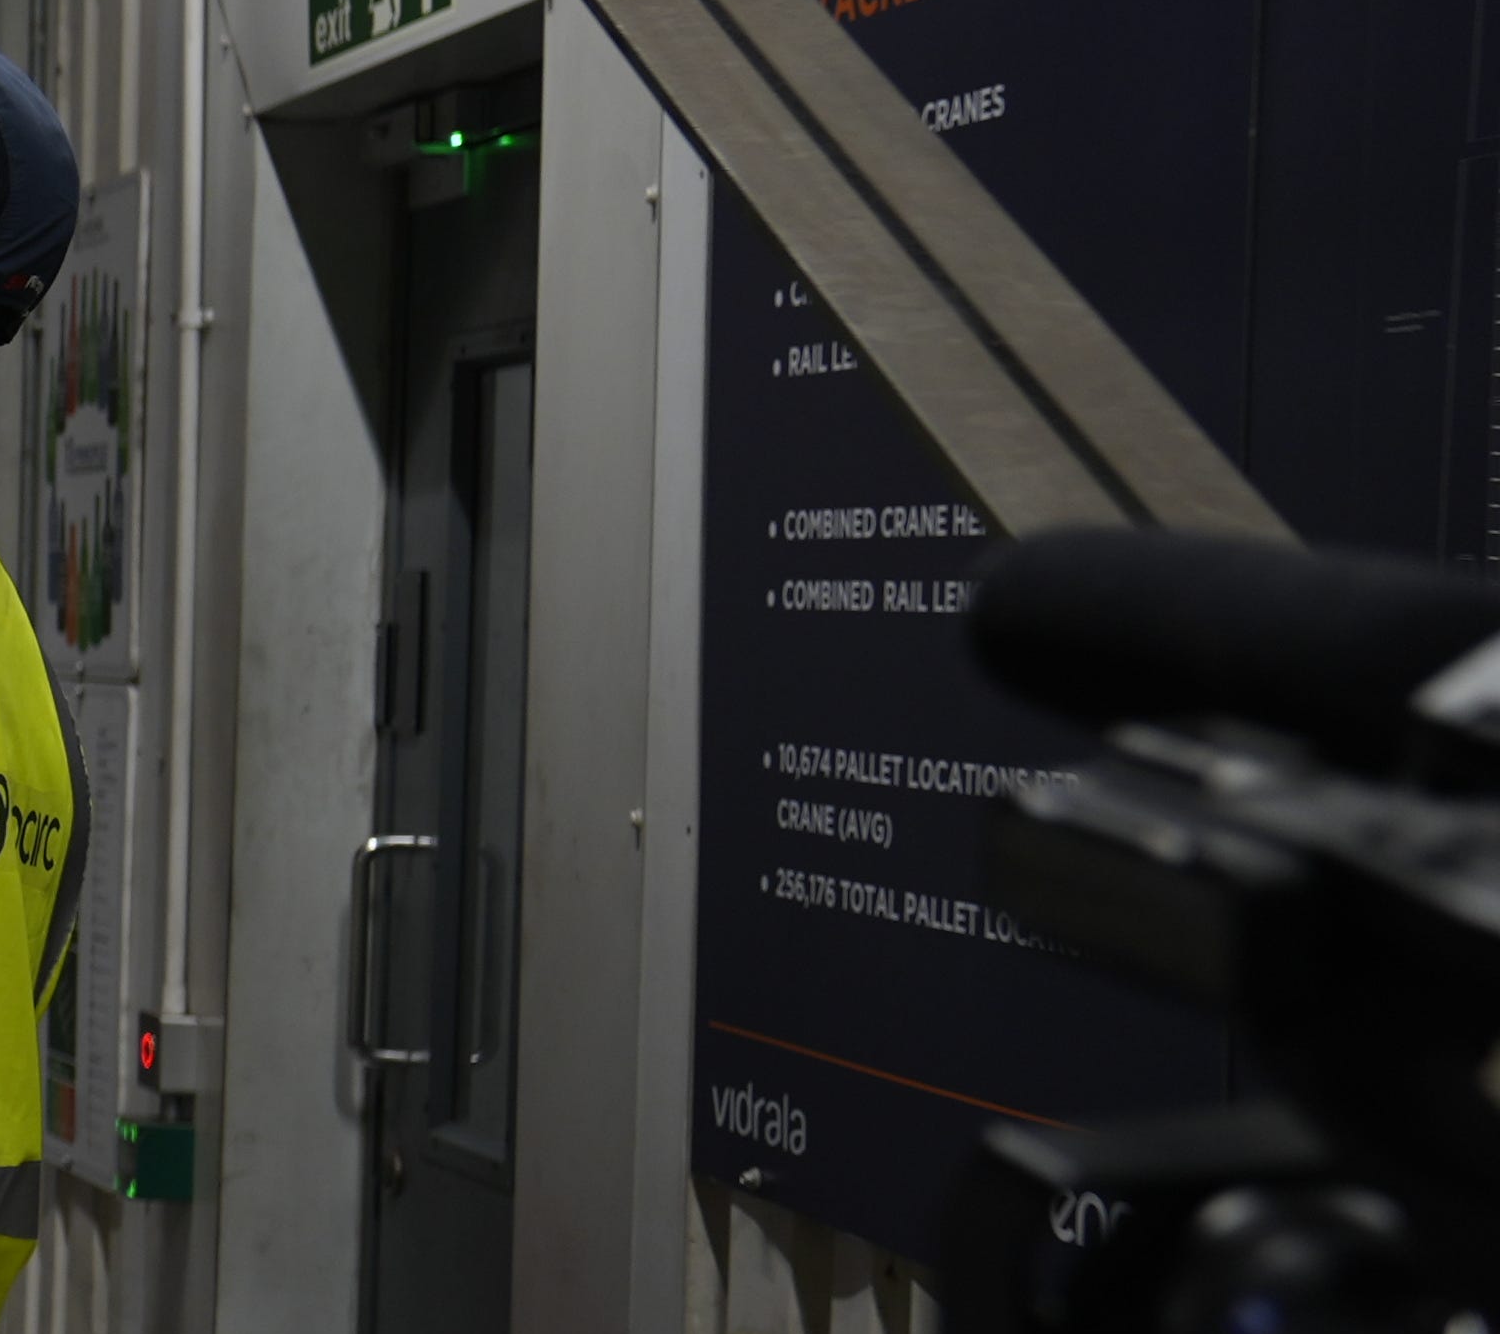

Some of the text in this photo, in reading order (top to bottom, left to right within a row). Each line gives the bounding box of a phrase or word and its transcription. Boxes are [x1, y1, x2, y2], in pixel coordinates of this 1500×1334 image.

[918, 85, 1004, 136] CRANES
[789, 343, 827, 376] RAIL
[784, 507, 876, 540] COMBINED
[881, 505, 948, 537] CRANE
[783, 580, 874, 611] COMBINED
[884, 581, 928, 612] RAIL
[779, 744, 831, 777] 10,674
[835, 750, 903, 785] PALLET
[778, 799, 892, 848] CRANE (AVG)
[776, 868, 835, 907] 256,176
[840, 880, 899, 921] TOTAL
[904, 892, 979, 935] PALLET
[712, 1083, 806, 1155] vidrala
